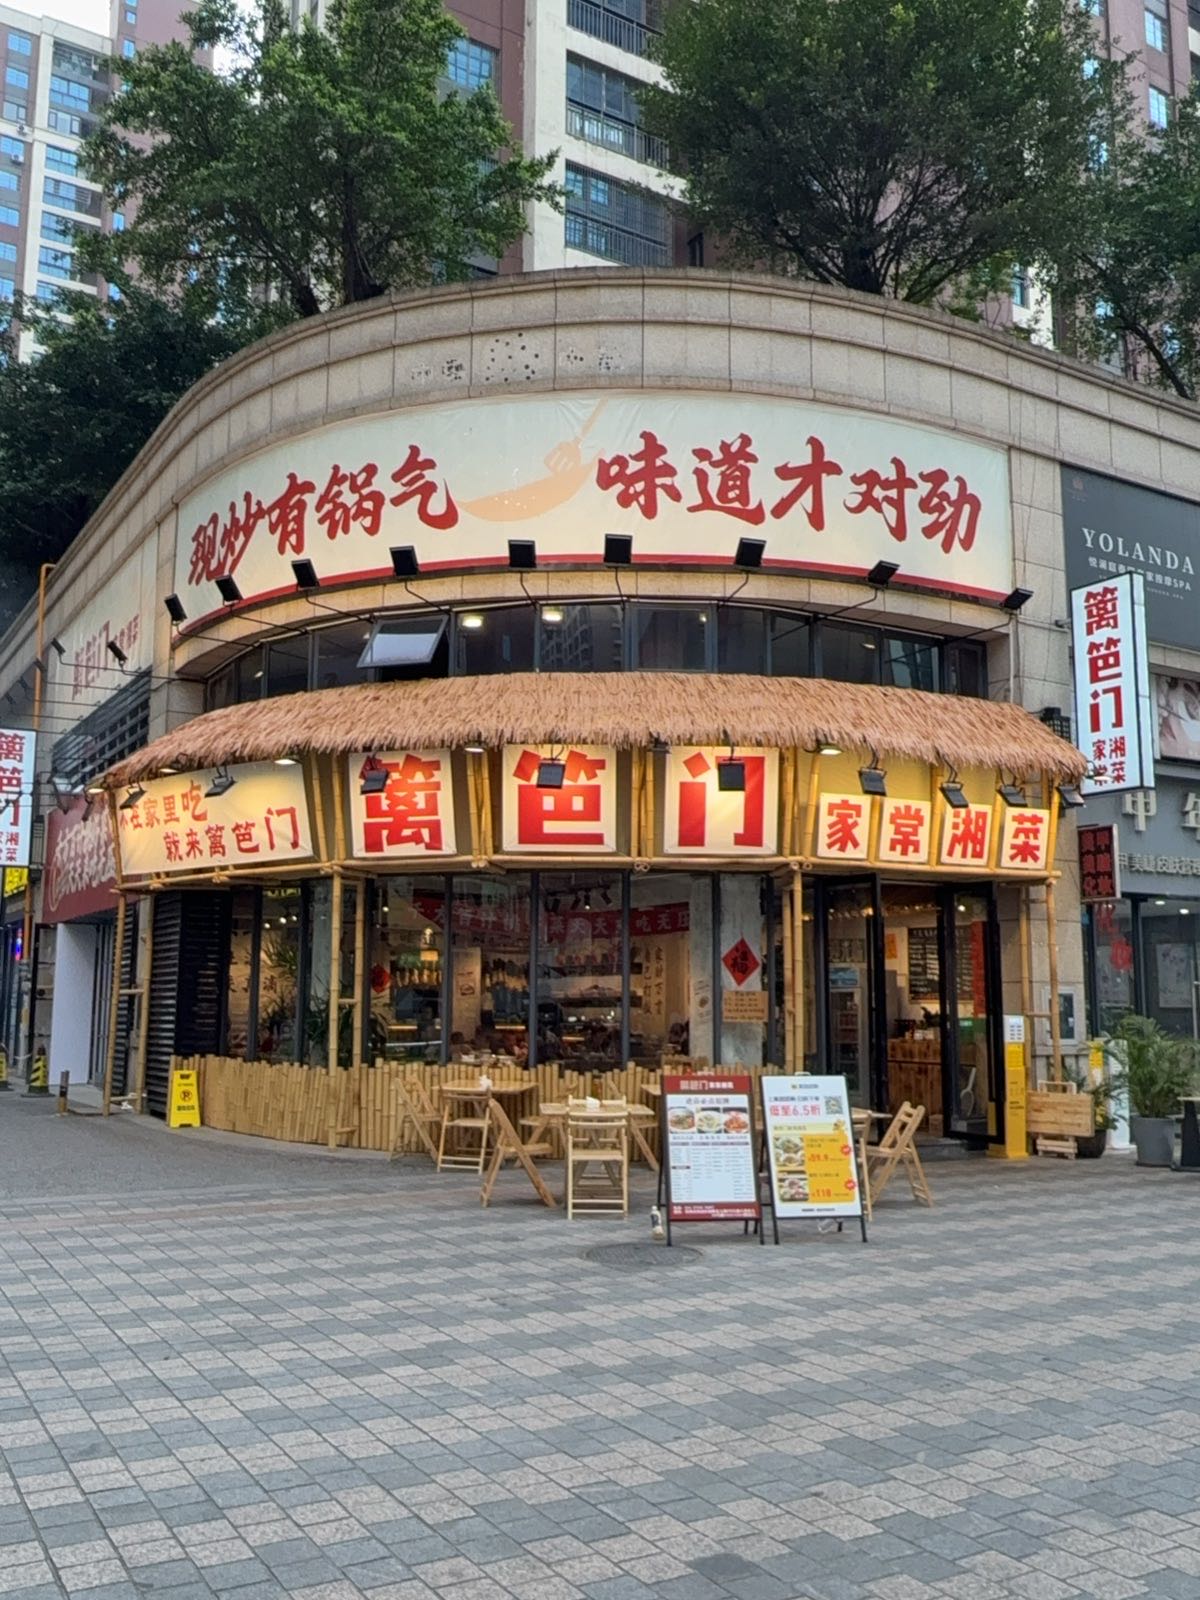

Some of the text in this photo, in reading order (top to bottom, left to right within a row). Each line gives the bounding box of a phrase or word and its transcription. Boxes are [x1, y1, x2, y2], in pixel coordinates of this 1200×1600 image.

[188, 445, 458, 585] 现炒有锅气
[596, 431, 982, 554] 味道才对劲
[1082, 527, 1195, 575] YOLANDA
[1084, 586, 1124, 733] 篱笆门
[162, 806, 301, 862] 就来篱笆门
